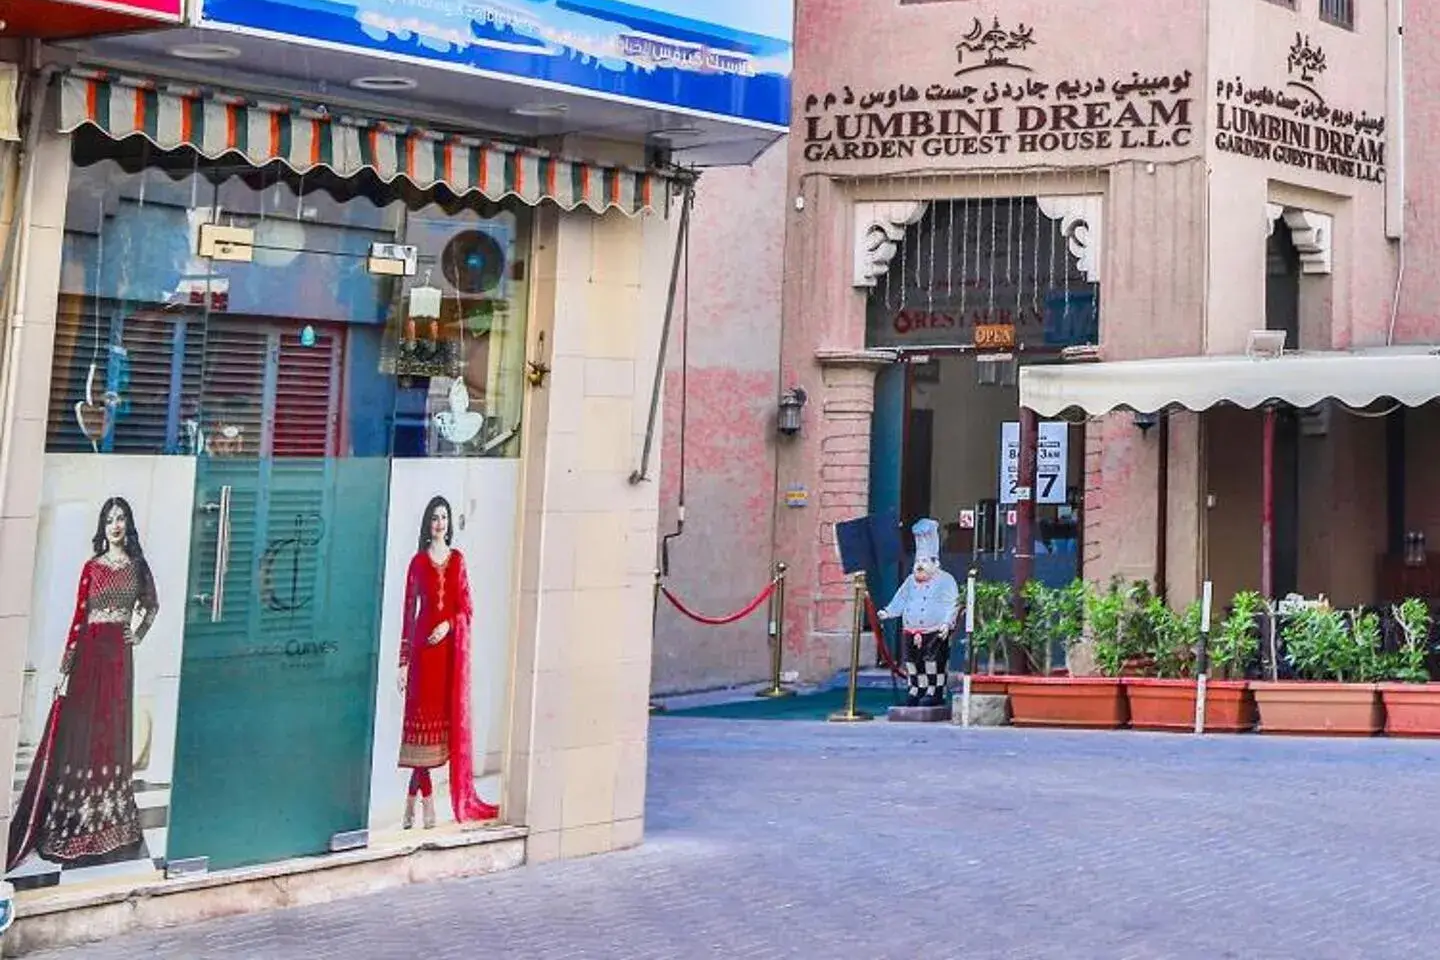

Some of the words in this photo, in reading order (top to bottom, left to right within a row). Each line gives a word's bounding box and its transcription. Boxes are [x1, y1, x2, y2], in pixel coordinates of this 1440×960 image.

[859, 83, 920, 110] هاوس
[924, 83, 979, 105] جست
[1055, 77, 1106, 101] دريم
[1111, 69, 1193, 102] لومبيني
[804, 107, 1003, 143] LUMBINI
[1015, 97, 1194, 133] DREAM
[1216, 103, 1311, 150] LUMBINI
[1313, 126, 1386, 167] DREAM
[803, 139, 915, 162] GARDEN
[921, 134, 1011, 158] GUEST
[1017, 130, 1112, 153] HOUSE
[1120, 128, 1192, 150] L.L.C
[1215, 132, 1272, 161] GARDEN
[1272, 145, 1317, 170] GUEST
[1315, 154, 1356, 179] HOUSE
[974, 326, 1013, 344] OPEN
